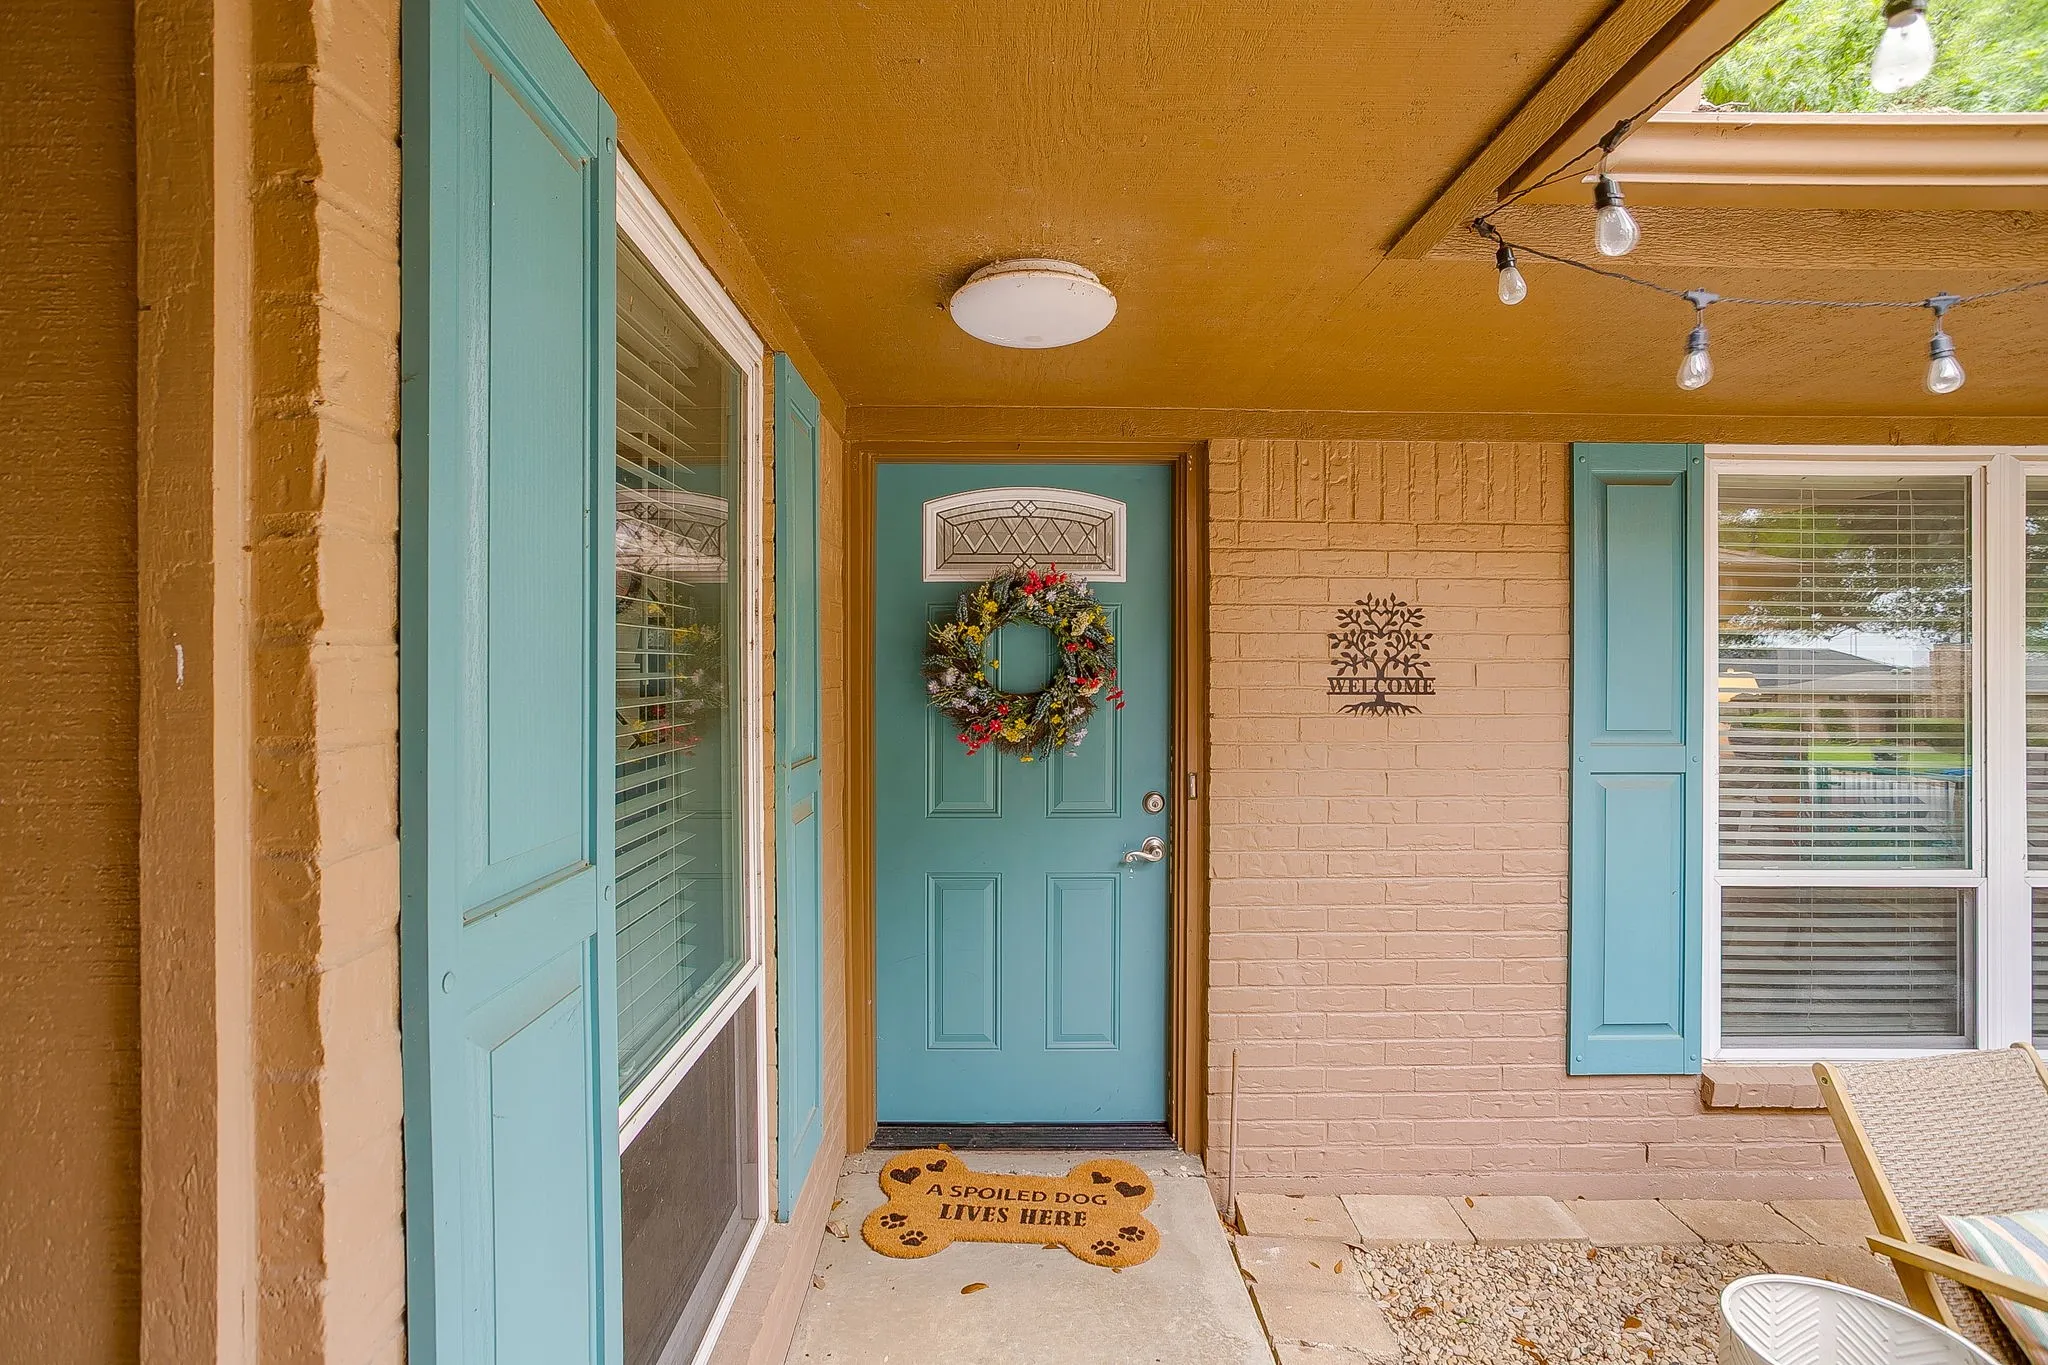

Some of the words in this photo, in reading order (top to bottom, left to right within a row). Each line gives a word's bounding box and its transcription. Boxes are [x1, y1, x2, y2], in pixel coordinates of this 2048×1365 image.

[1328, 679, 1435, 693] WELCOME
[926, 1183, 943, 1196] A
[950, 1185, 1047, 1203] SPOILED
[1055, 1191, 1108, 1206] DOG
[938, 1203, 1009, 1223] LIVES
[1020, 1207, 1087, 1227] HERE
